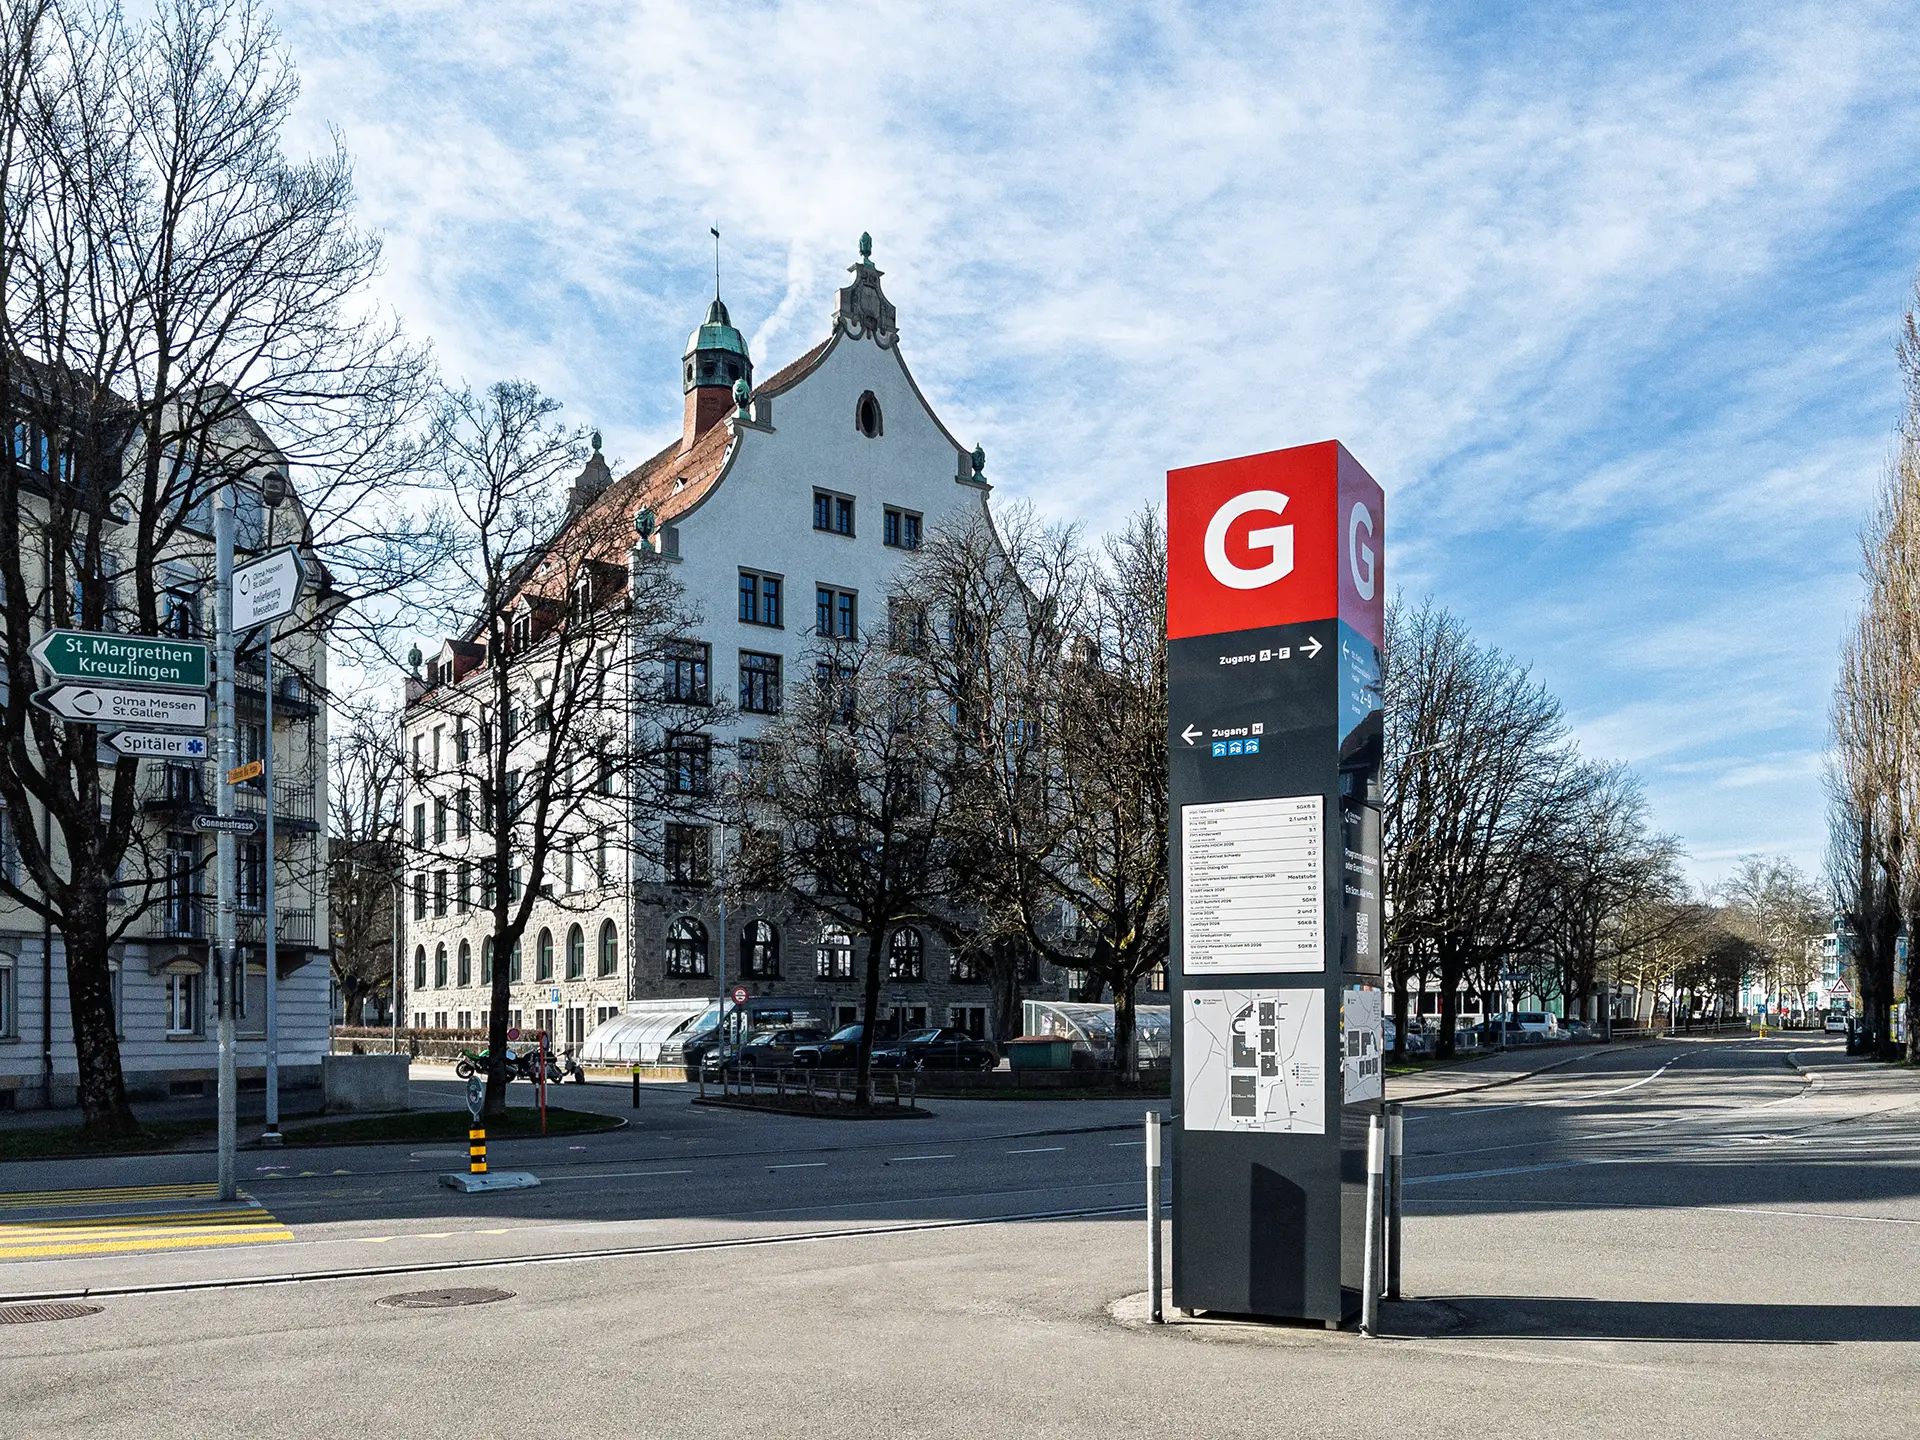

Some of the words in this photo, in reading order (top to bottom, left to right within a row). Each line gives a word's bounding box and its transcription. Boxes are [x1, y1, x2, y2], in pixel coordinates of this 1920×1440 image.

[1204, 490, 1294, 590] G
[1349, 502, 1374, 601] G
[253, 570, 265, 581] Olma
[266, 564, 284, 574] Messen
[253, 588, 281, 605] Anlieferung
[252, 600, 280, 617] Messebüro
[66, 638, 88, 654] St.
[92, 640, 192, 662] Margrethen
[1219, 652, 1256, 665] Zugang
[79, 657, 180, 680] Kreuzlingen
[112, 696, 146, 707] Olma
[150, 698, 196, 711] Messen
[112, 706, 169, 719] St.Gallen
[1212, 726, 1248, 738] Zugang
[124, 736, 182, 752] Spitäler
[201, 818, 254, 830] Sonnenstrasse
